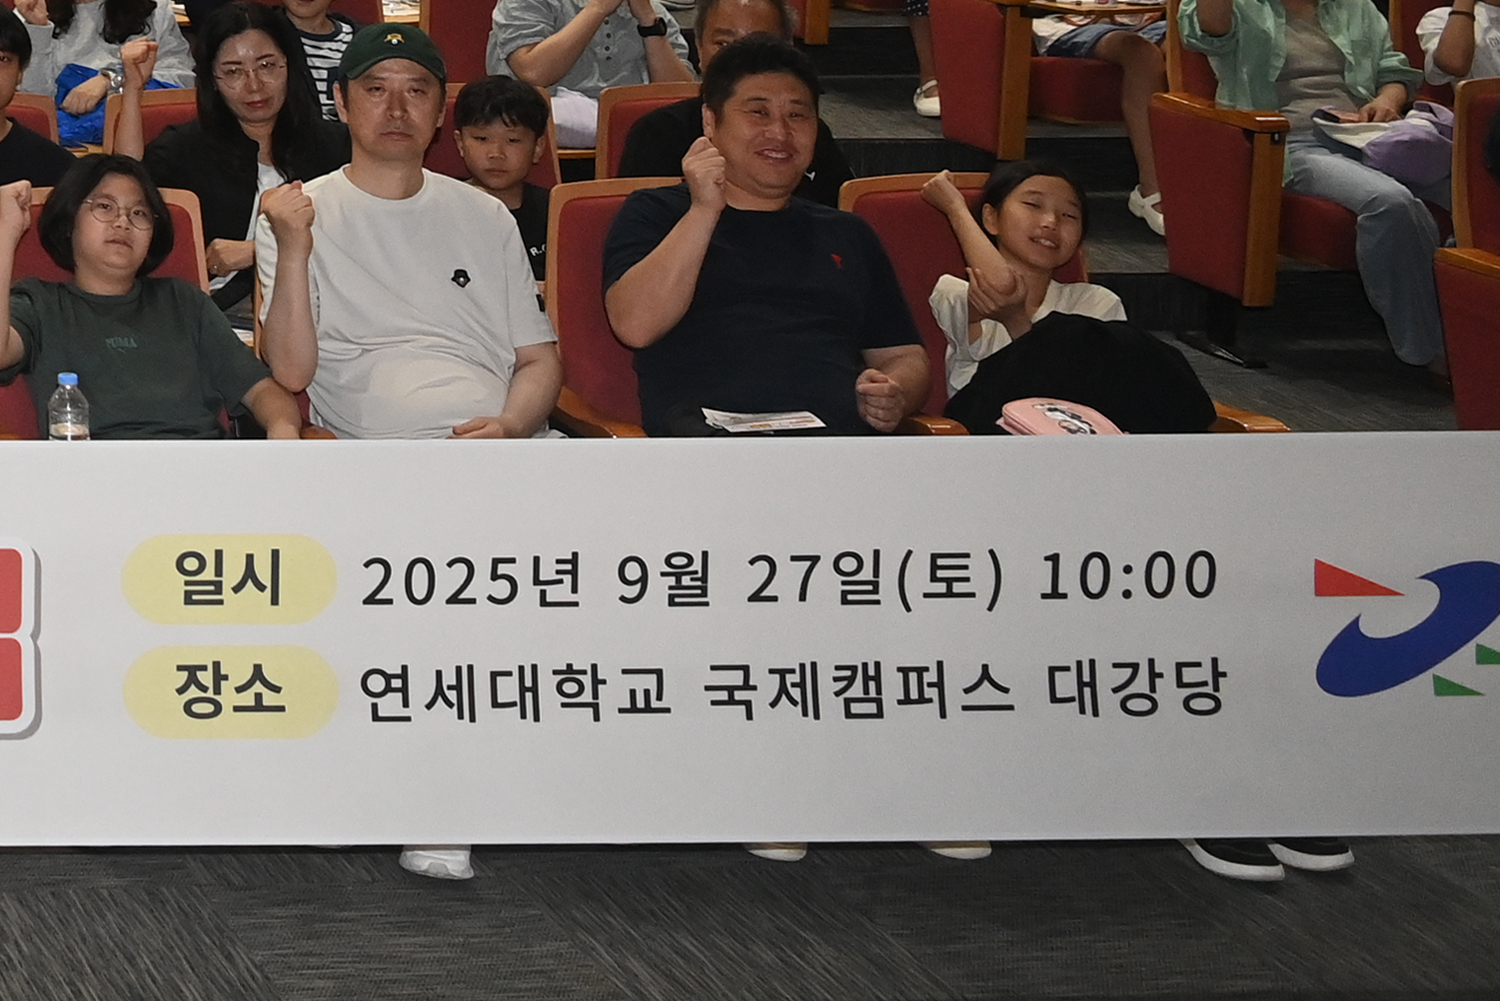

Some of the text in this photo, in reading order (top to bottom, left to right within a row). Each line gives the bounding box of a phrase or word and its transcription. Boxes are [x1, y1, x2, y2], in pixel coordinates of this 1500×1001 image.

[175, 548, 1218, 612] 일시 2025년 9월 27일(토) 10:00
[175, 656, 1228, 723] 장소 연세대학교 국제캠퍼스 대강당
